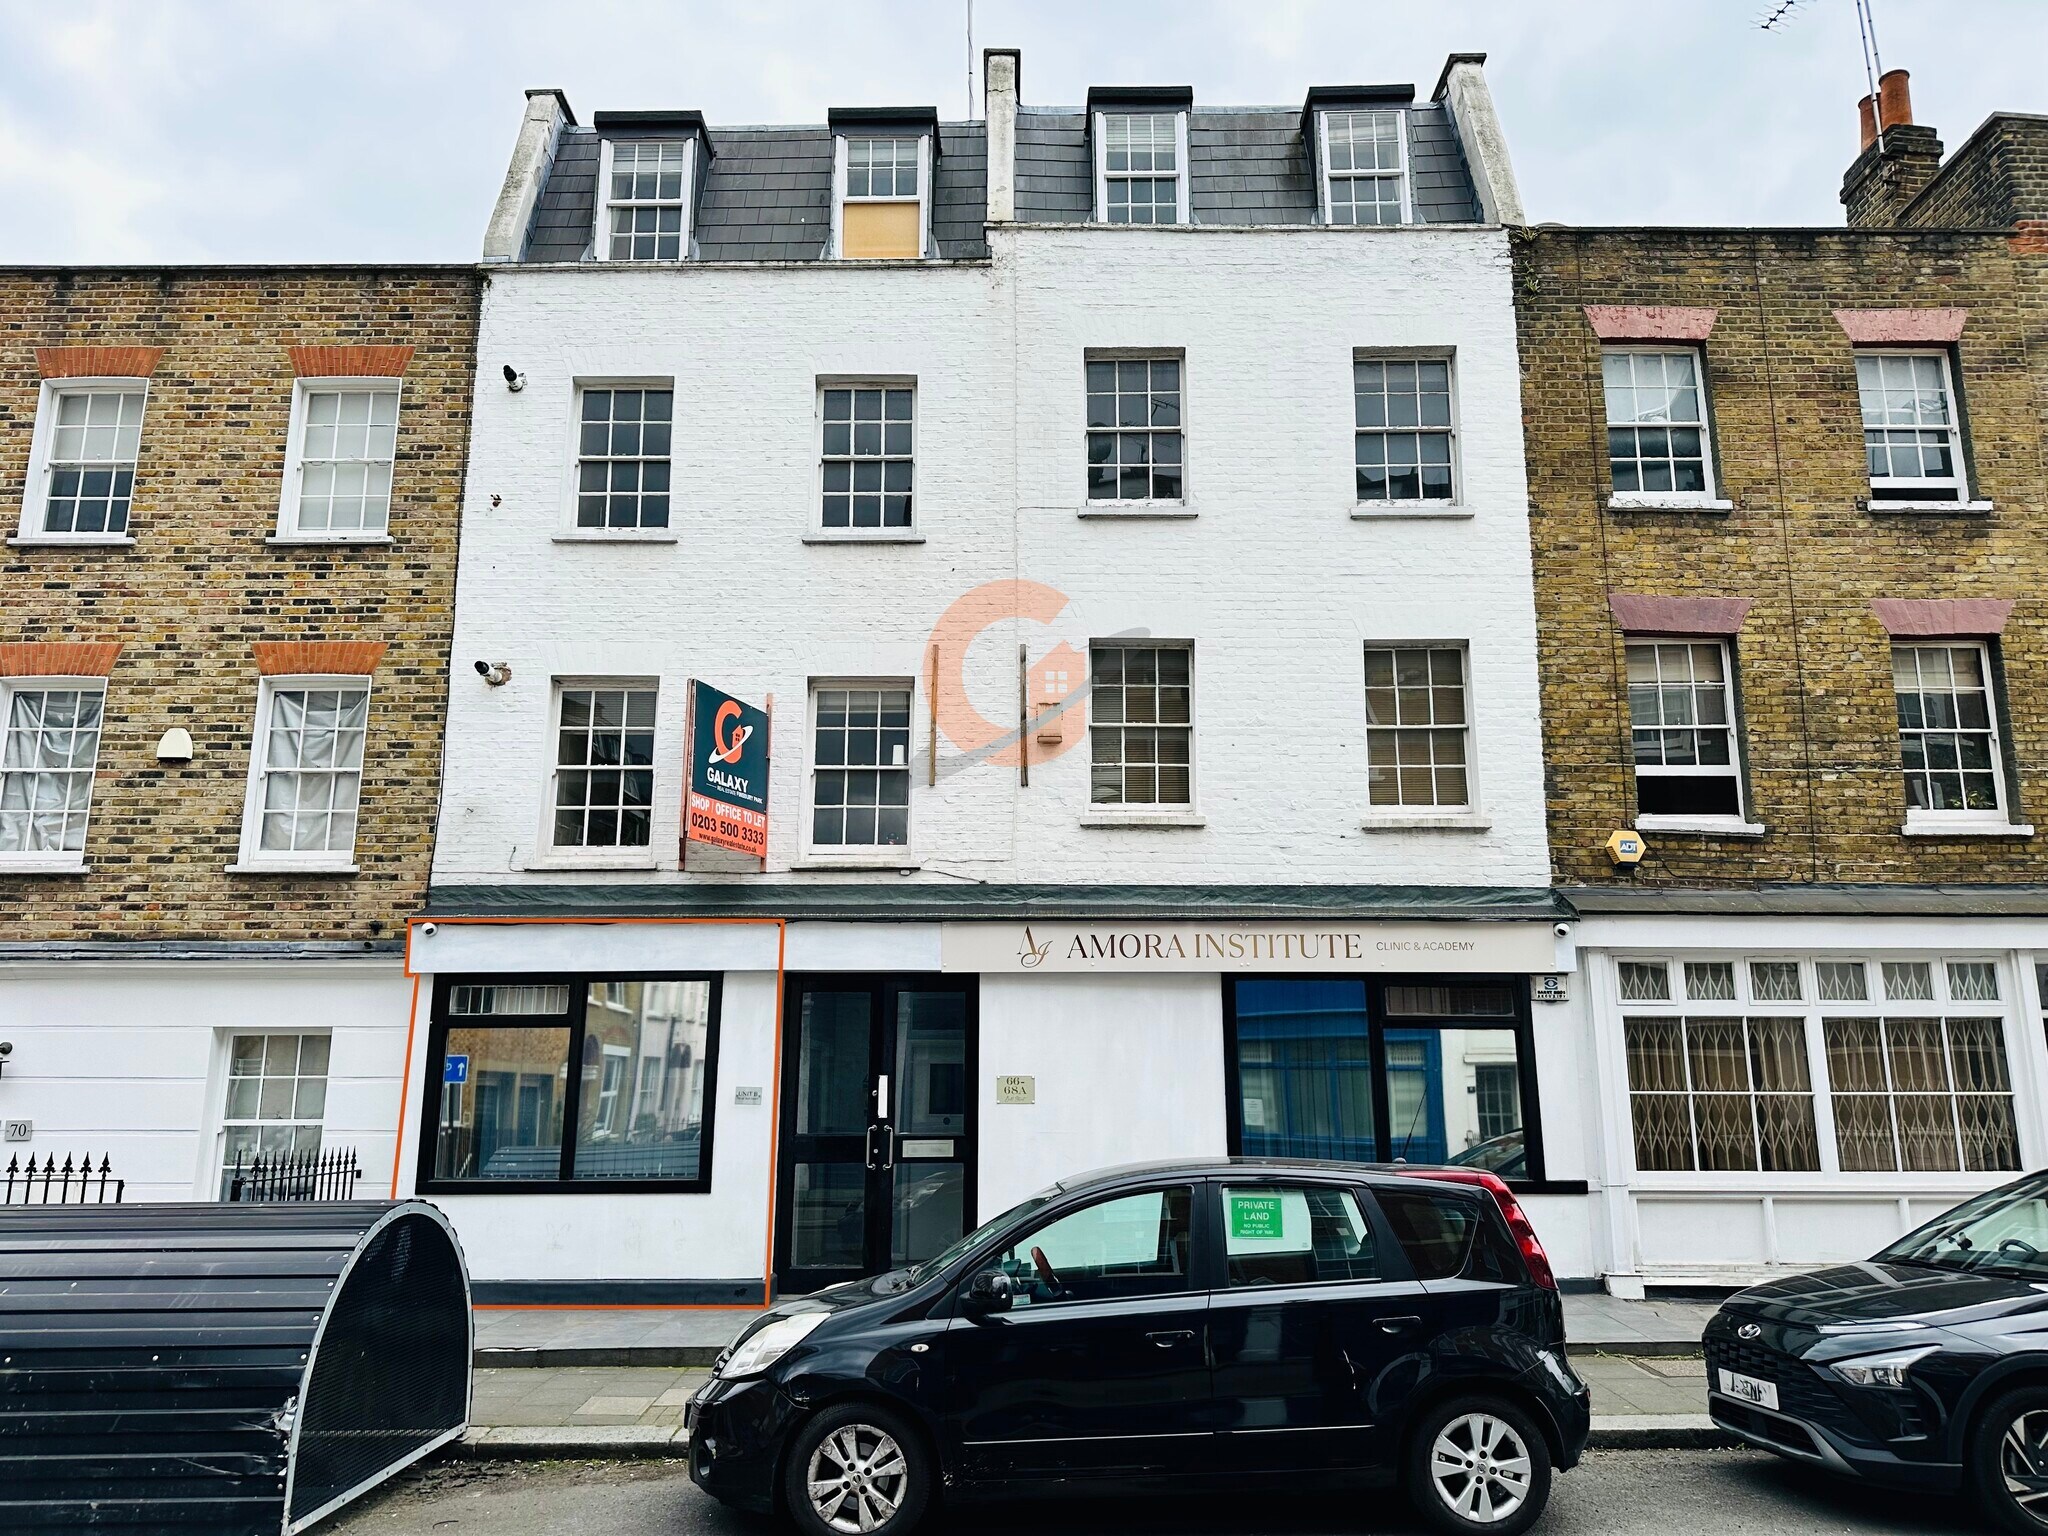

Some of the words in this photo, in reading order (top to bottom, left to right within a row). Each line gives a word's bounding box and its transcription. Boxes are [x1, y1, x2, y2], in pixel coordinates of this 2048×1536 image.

[707, 767, 749, 793] GALAXY
[754, 796, 763, 804] PARK
[692, 795, 710, 811] SHOP
[716, 803, 742, 821] OFFICE
[743, 811, 752, 824] TO
[754, 814, 766, 828] LET
[692, 813, 717, 832] 0203
[720, 821, 738, 838] 500
[742, 827, 764, 845] 3333
[699, 833, 756, 853] www.galaxyrealestate.co.uk
[1621, 843, 1637, 851] ADT
[1067, 933, 1186, 959] AMORA
[1194, 933, 1363, 959] INSTITUTE
[1376, 941, 1411, 951] CLINIC
[1413, 941, 1422, 951] &
[1422, 941, 1475, 951] ACADEMY
[1006, 1077, 1025, 1085] 66-
[1004, 1086, 1027, 1095] 68A
[10, 1124, 27, 1137] 70
[1238, 1201, 1275, 1209] PRIVATE
[1244, 1212, 1270, 1220] LAND
